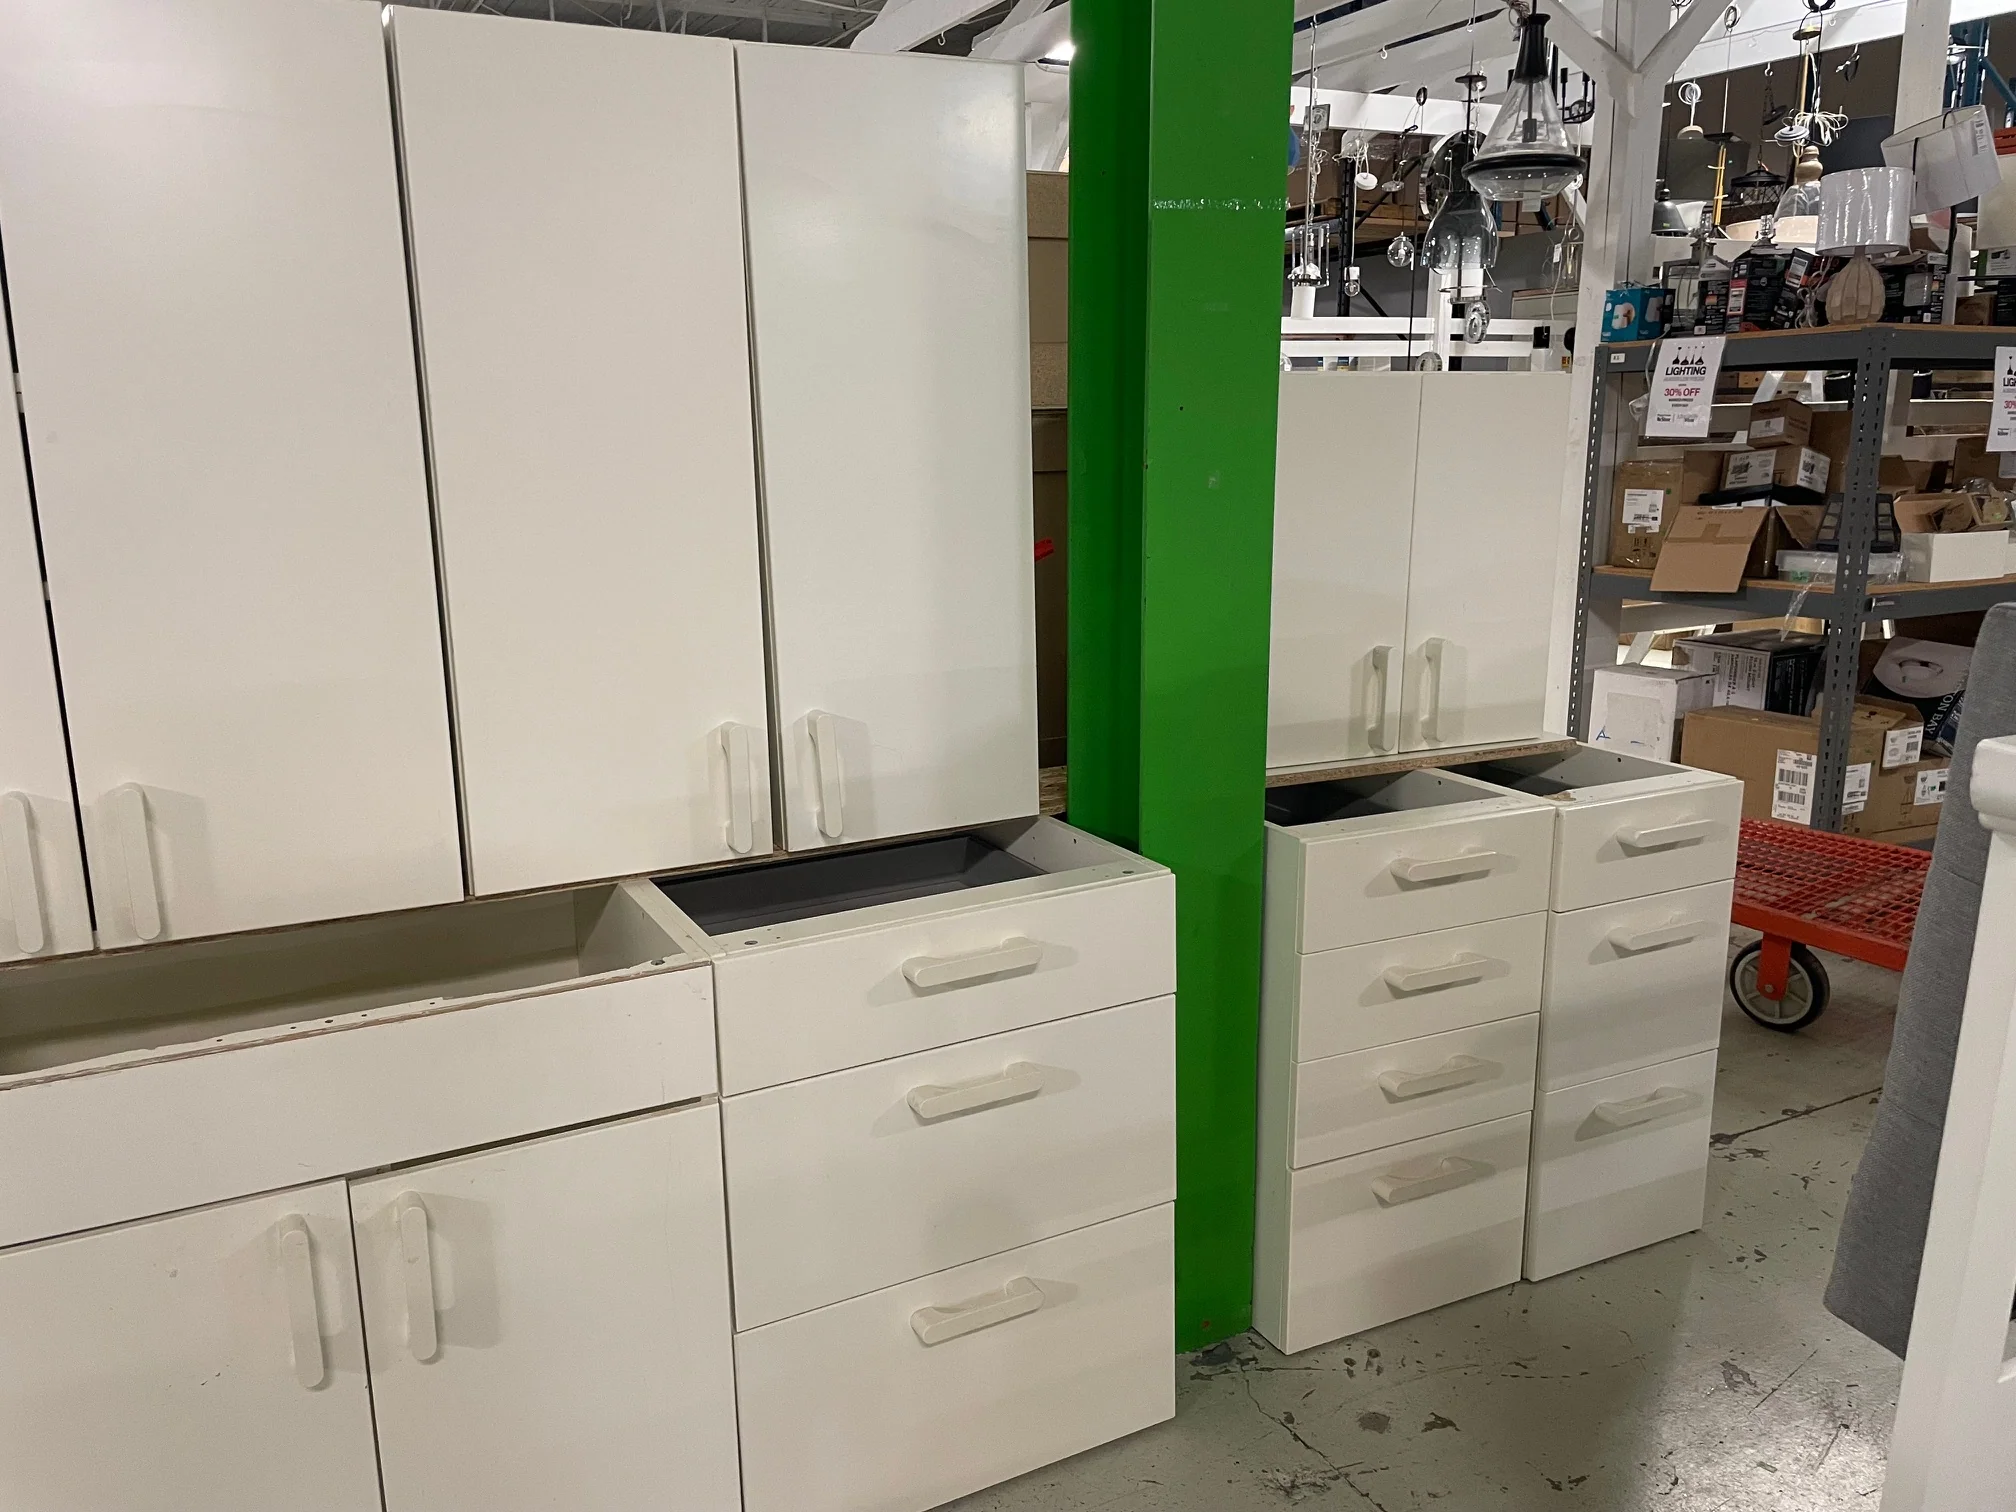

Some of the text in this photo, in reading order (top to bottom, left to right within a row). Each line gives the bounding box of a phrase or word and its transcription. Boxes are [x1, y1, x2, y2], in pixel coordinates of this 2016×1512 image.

[1665, 366, 1706, 376] LIGHTING
[1664, 388, 1701, 397] 30% OFF
[1926, 713, 1944, 734] BAY
